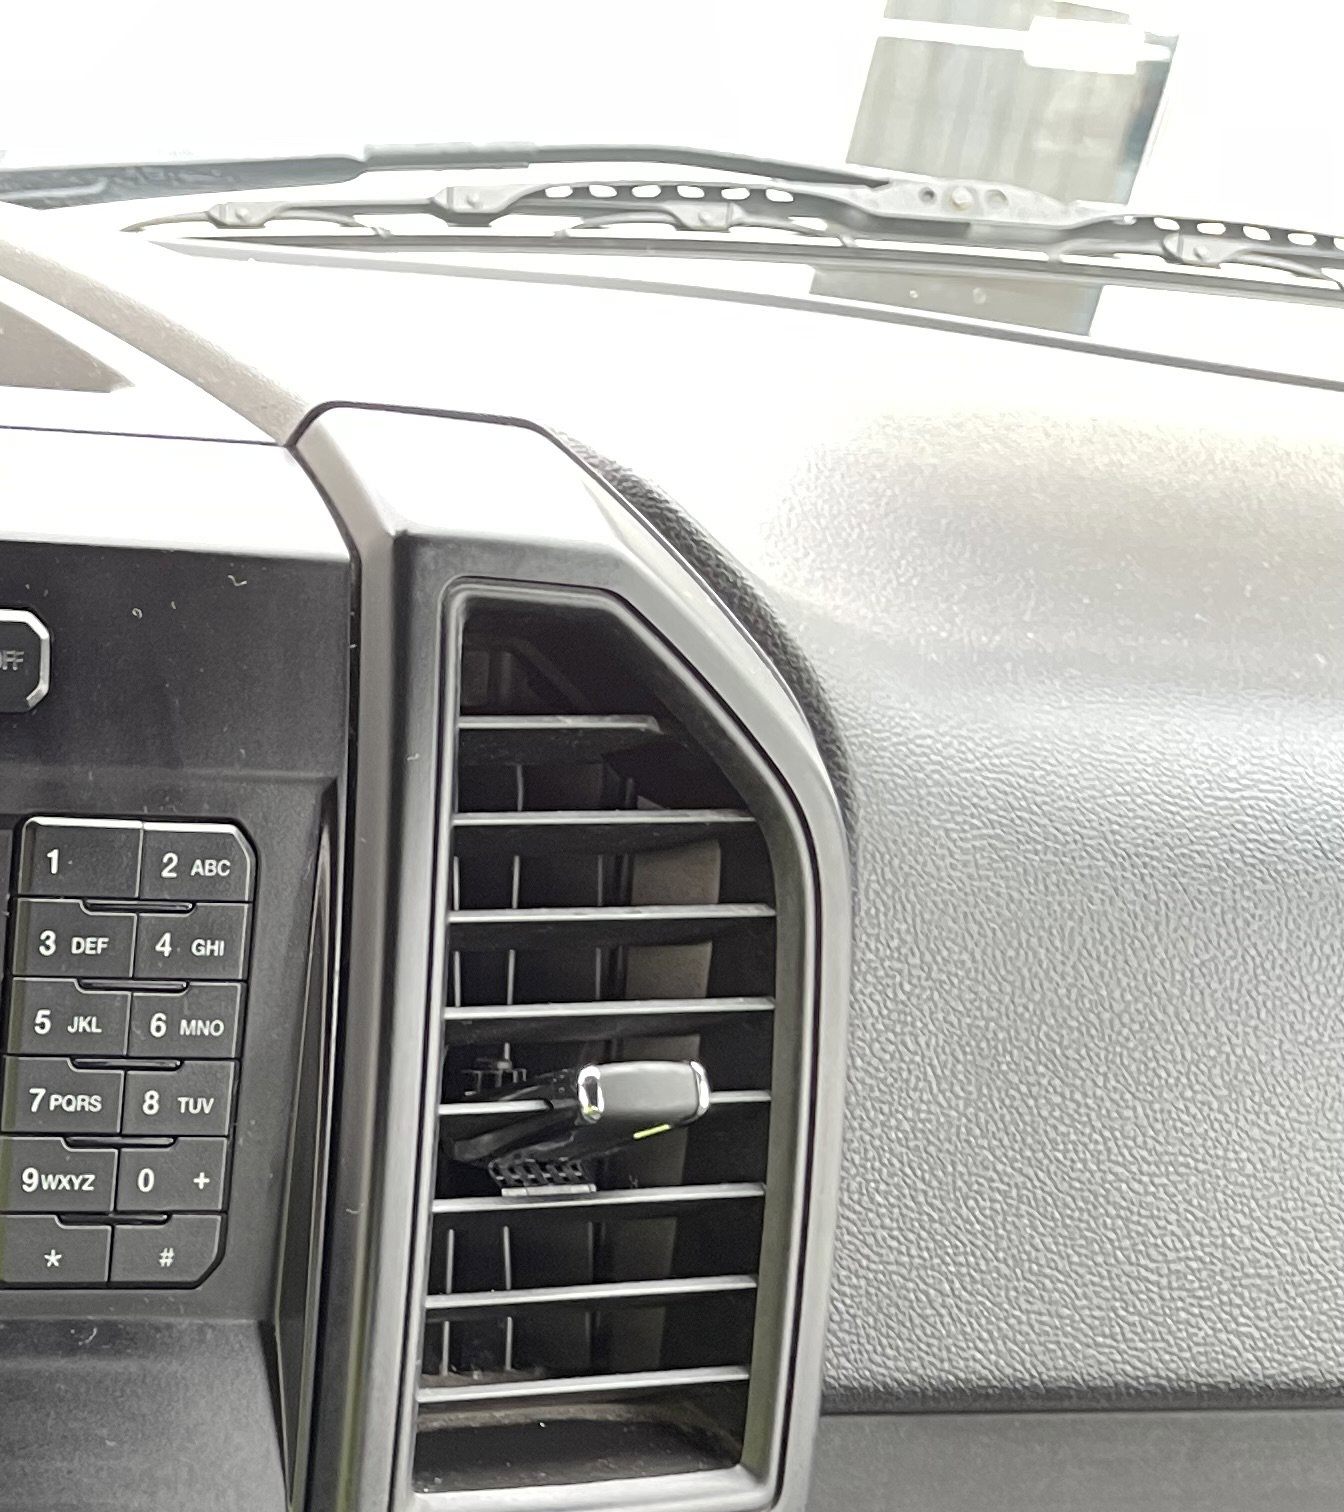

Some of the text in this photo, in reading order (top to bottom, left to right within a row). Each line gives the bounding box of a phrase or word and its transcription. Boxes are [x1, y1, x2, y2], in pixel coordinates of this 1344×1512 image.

[46, 849, 59, 874] 1
[161, 852, 231, 878] 2 ABC
[39, 930, 110, 956] 3 DEF
[155, 932, 225, 957] 4 GHI
[34, 1009, 103, 1035] 5 JKL
[150, 1012, 225, 1038] 6 MNO
[29, 1087, 102, 1113] 7 PQRS
[142, 1090, 215, 1115] 8 TUV
[22, 1167, 96, 1193] 9 WXYZ
[137, 1168, 155, 1193] 0
